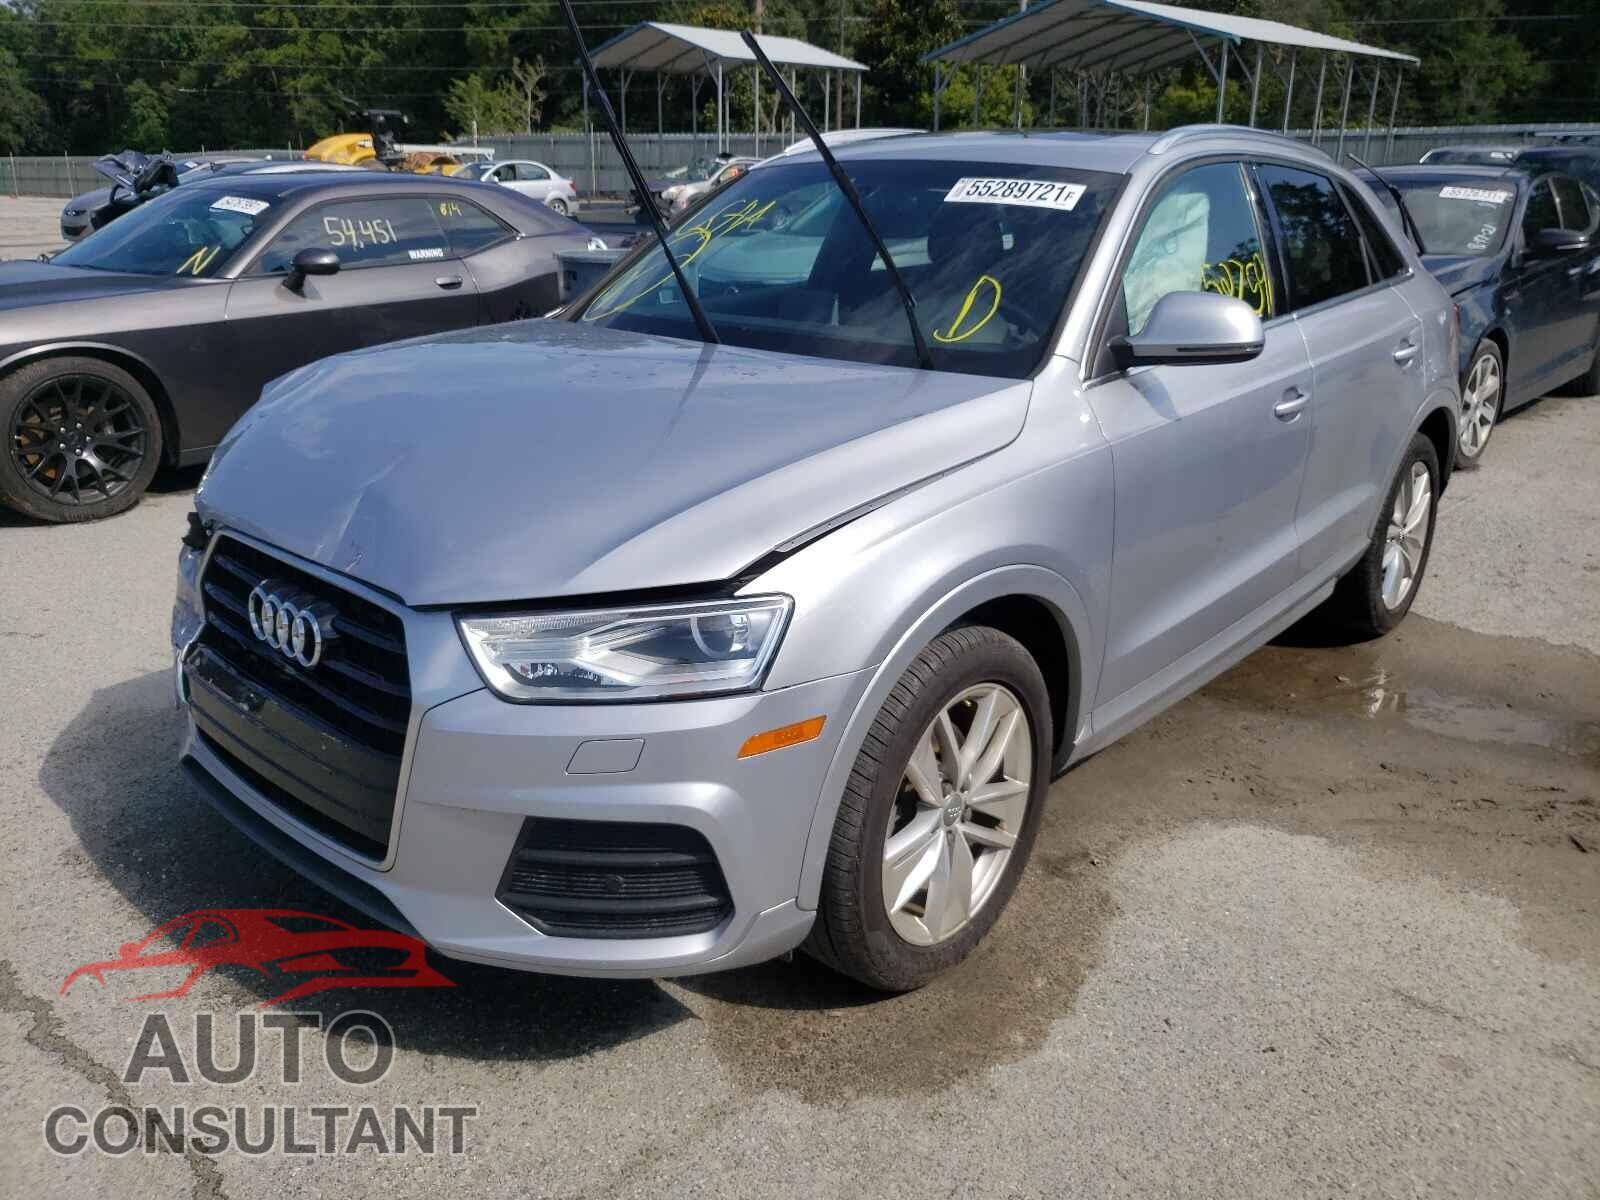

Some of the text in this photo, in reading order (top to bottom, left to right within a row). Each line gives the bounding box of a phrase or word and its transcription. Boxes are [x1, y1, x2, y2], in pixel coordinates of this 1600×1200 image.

[966, 179, 1068, 204] 55289721
[323, 216, 397, 251] 54,451
[408, 247, 444, 261] WARNING
[932, 275, 1002, 342] D
